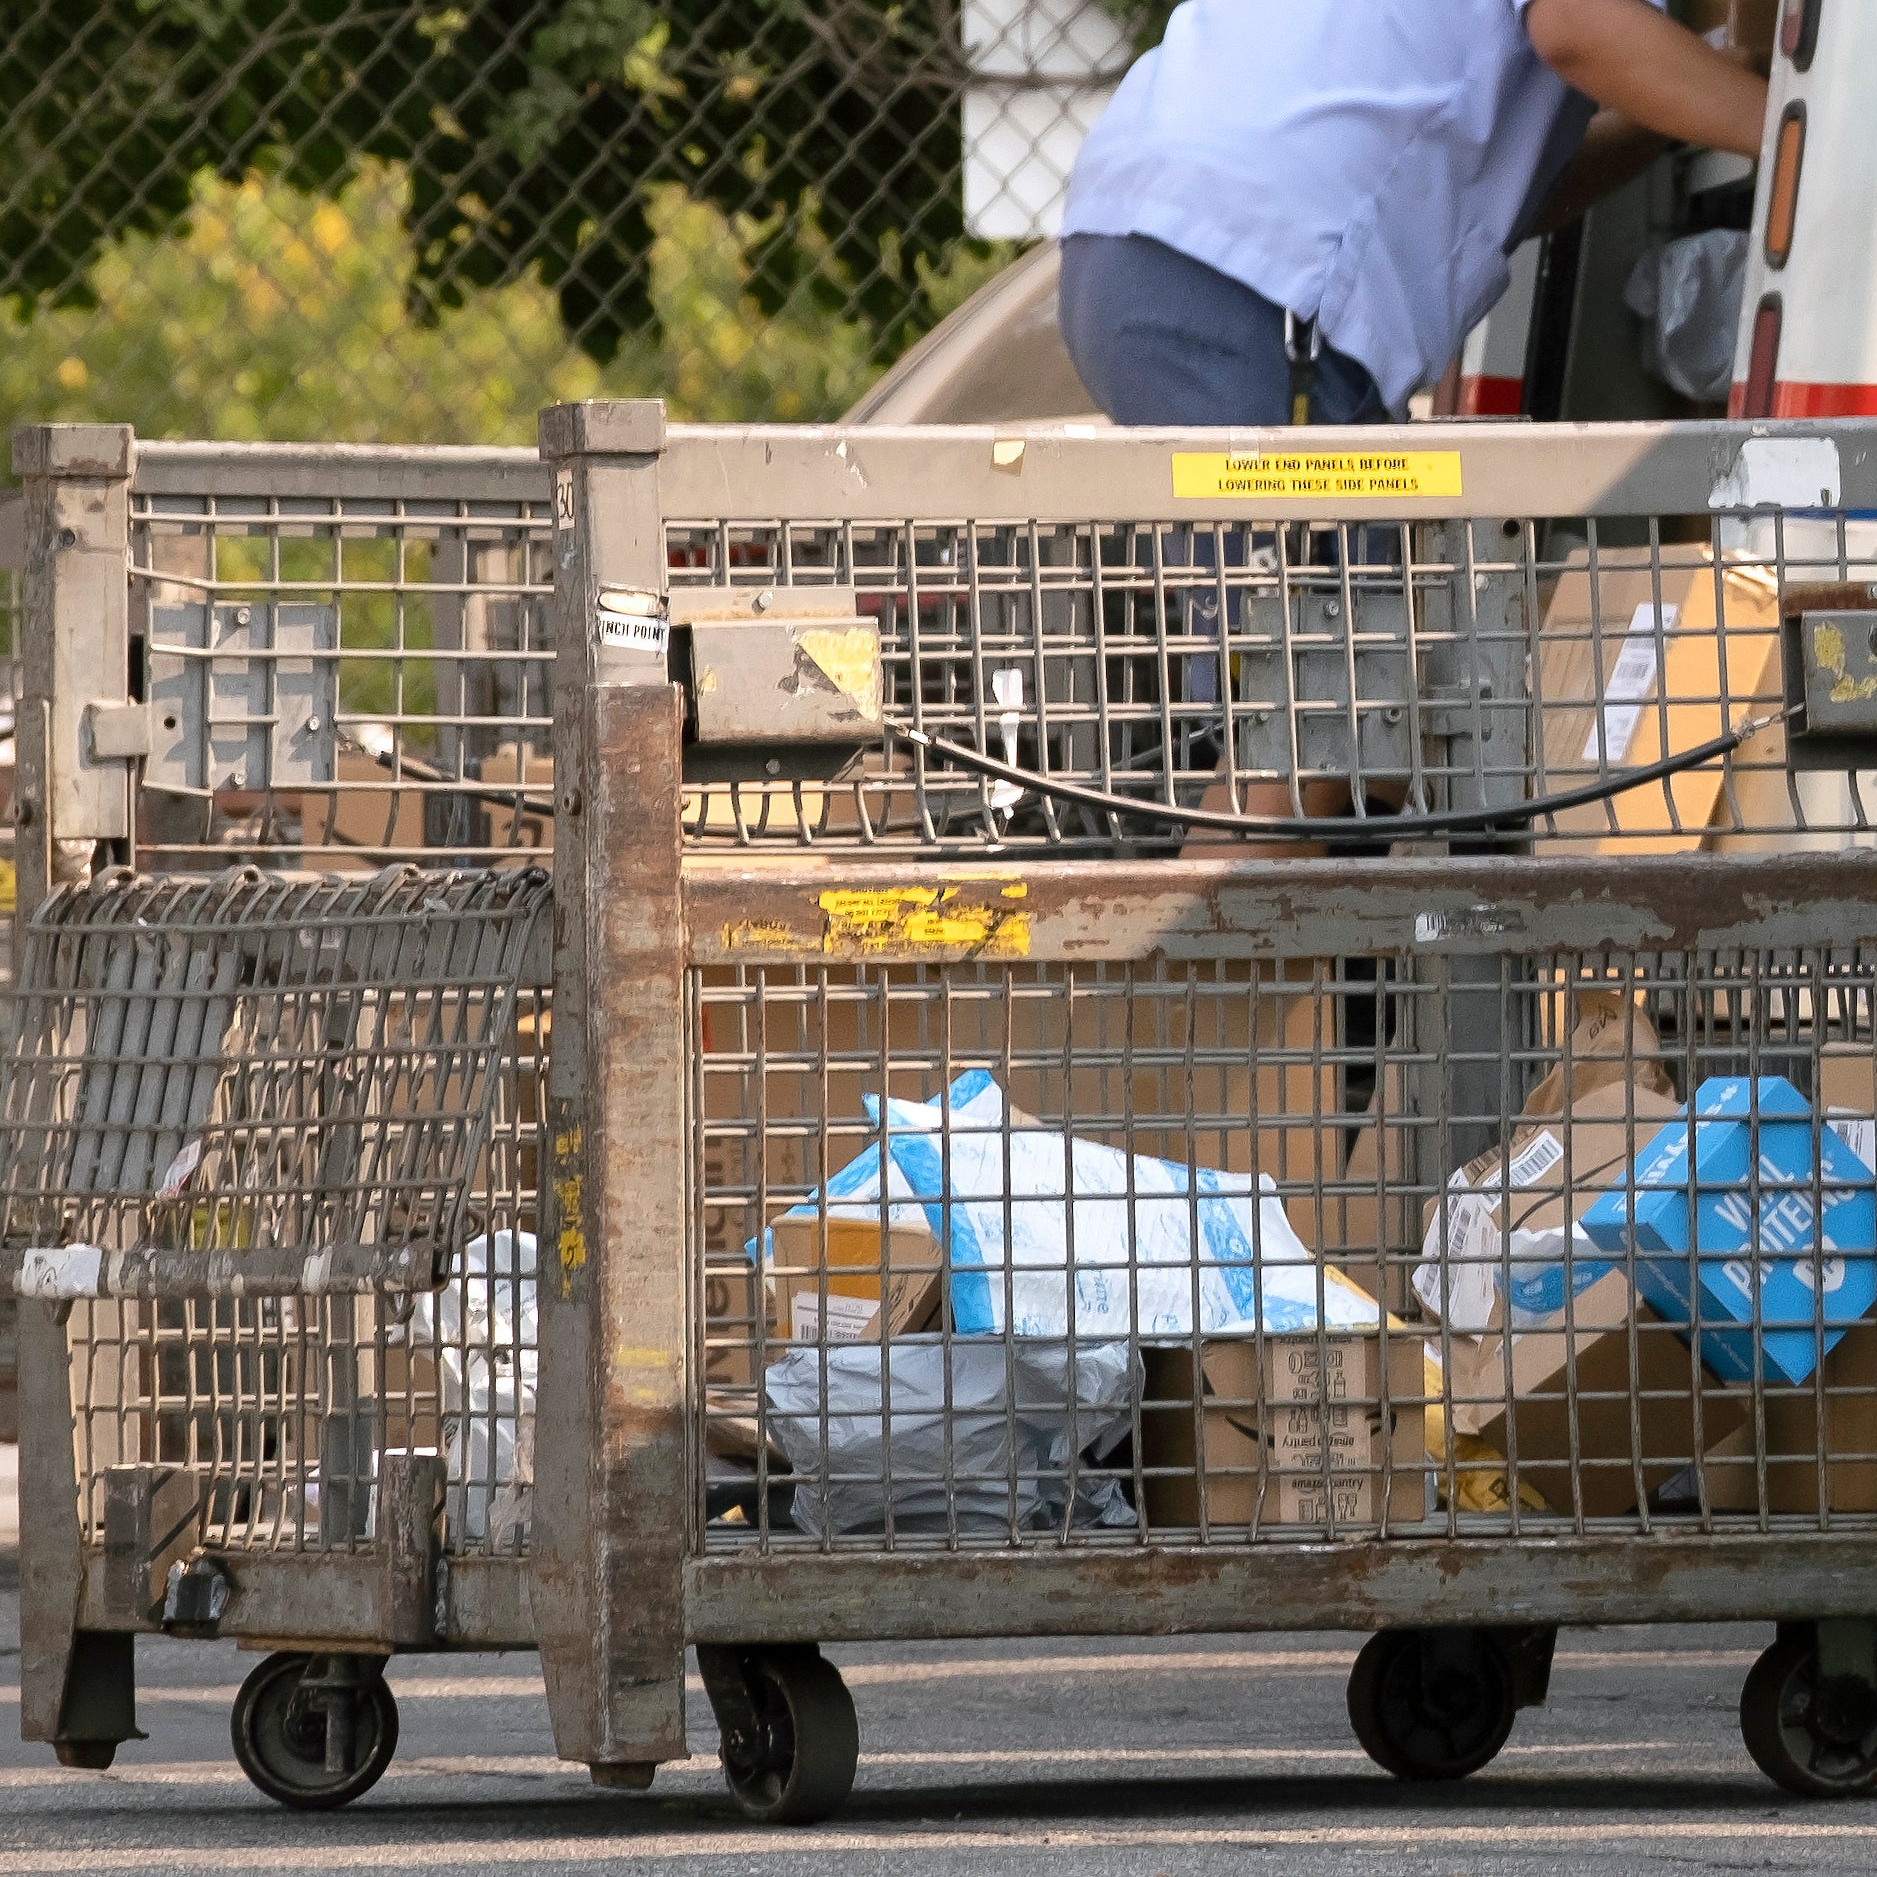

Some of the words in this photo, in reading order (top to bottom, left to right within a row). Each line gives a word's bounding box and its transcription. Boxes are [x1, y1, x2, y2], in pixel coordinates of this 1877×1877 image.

[1225, 459, 1271, 471] LOWER
[1305, 458, 1355, 471] PANELS
[1218, 479, 1286, 491] LOWERING
[1369, 479, 1419, 491] PANELS
[1713, 1154, 1796, 1234] VIAL
[1330, 1477, 1364, 1491] antry
